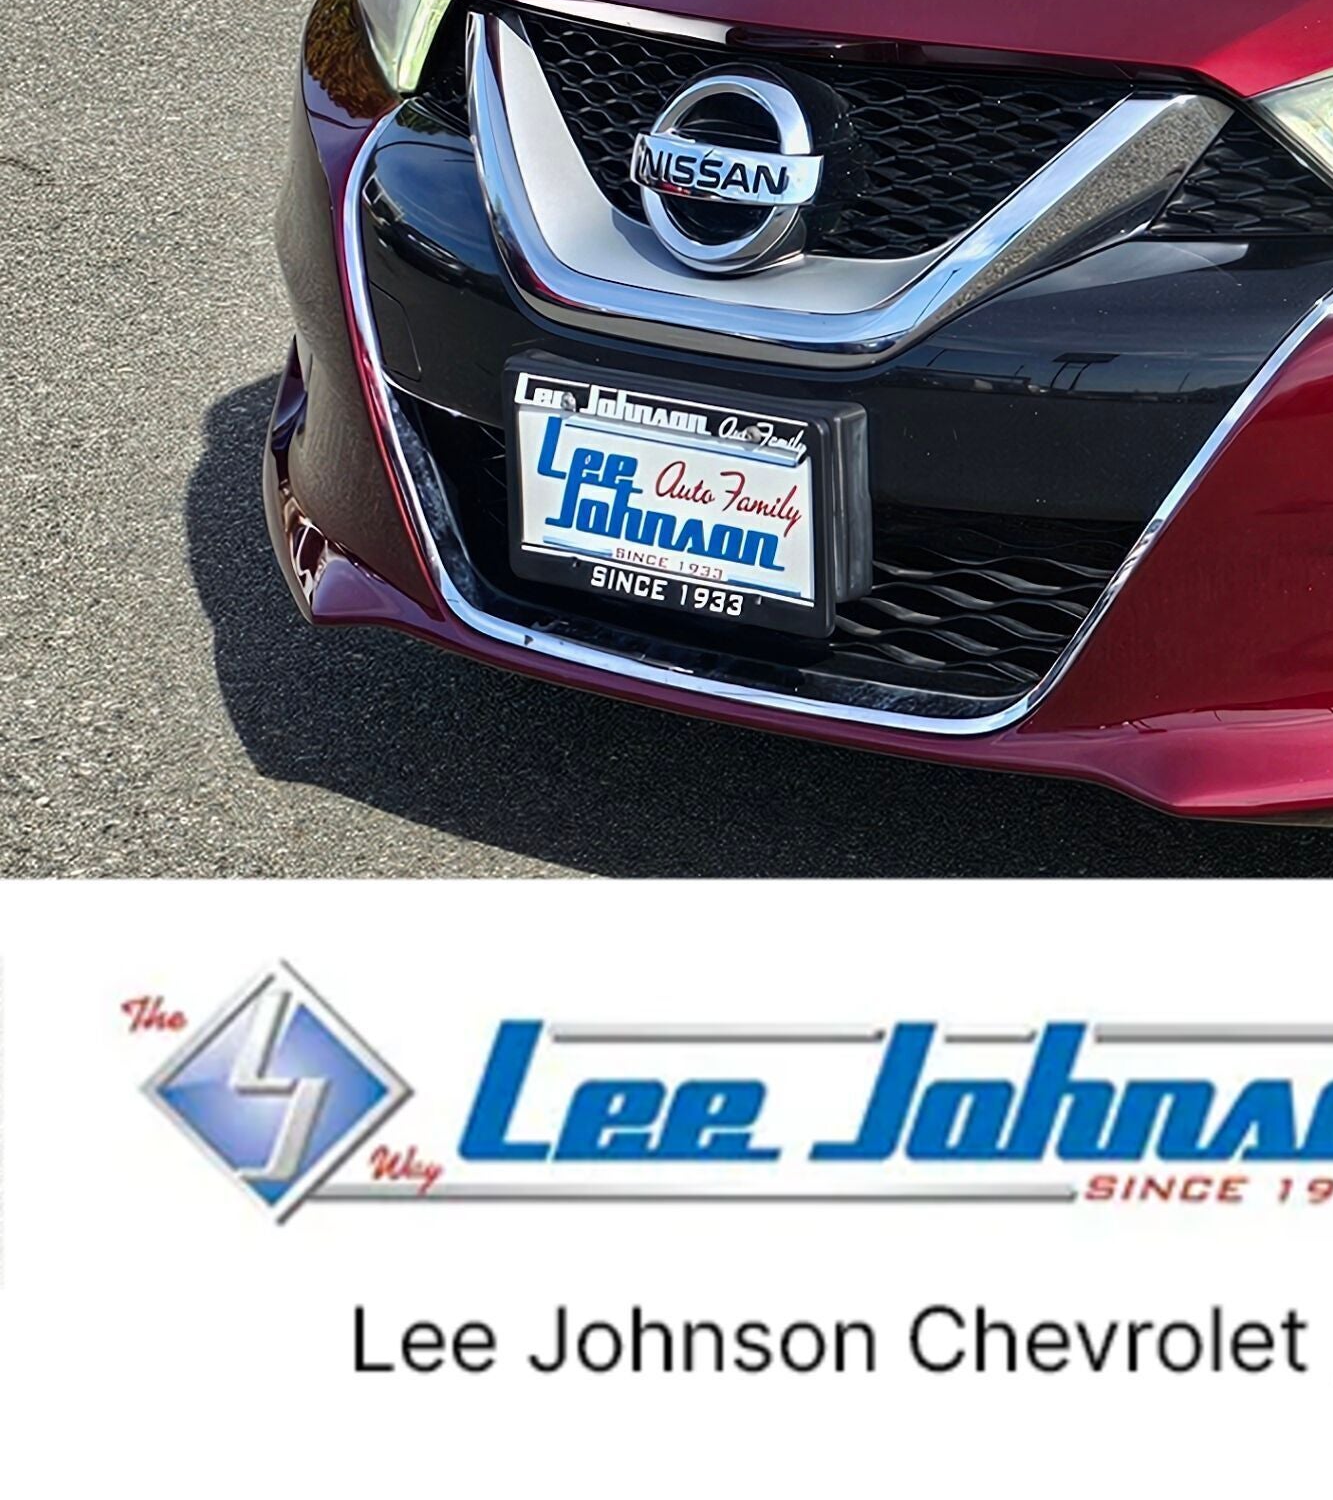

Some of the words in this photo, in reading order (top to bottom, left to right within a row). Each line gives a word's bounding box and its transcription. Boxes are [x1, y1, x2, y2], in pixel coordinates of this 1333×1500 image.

[641, 145, 790, 196] NISSAN
[580, 384, 711, 436] Johnson
[537, 416, 643, 493] Lee
[655, 461, 716, 505] Auto
[720, 471, 803, 538] Family
[545, 478, 785, 572] Johnson
[615, 547, 670, 570] SINCE
[679, 560, 723, 581] 1933
[590, 566, 669, 602] SINCE
[680, 587, 745, 617] 1933
